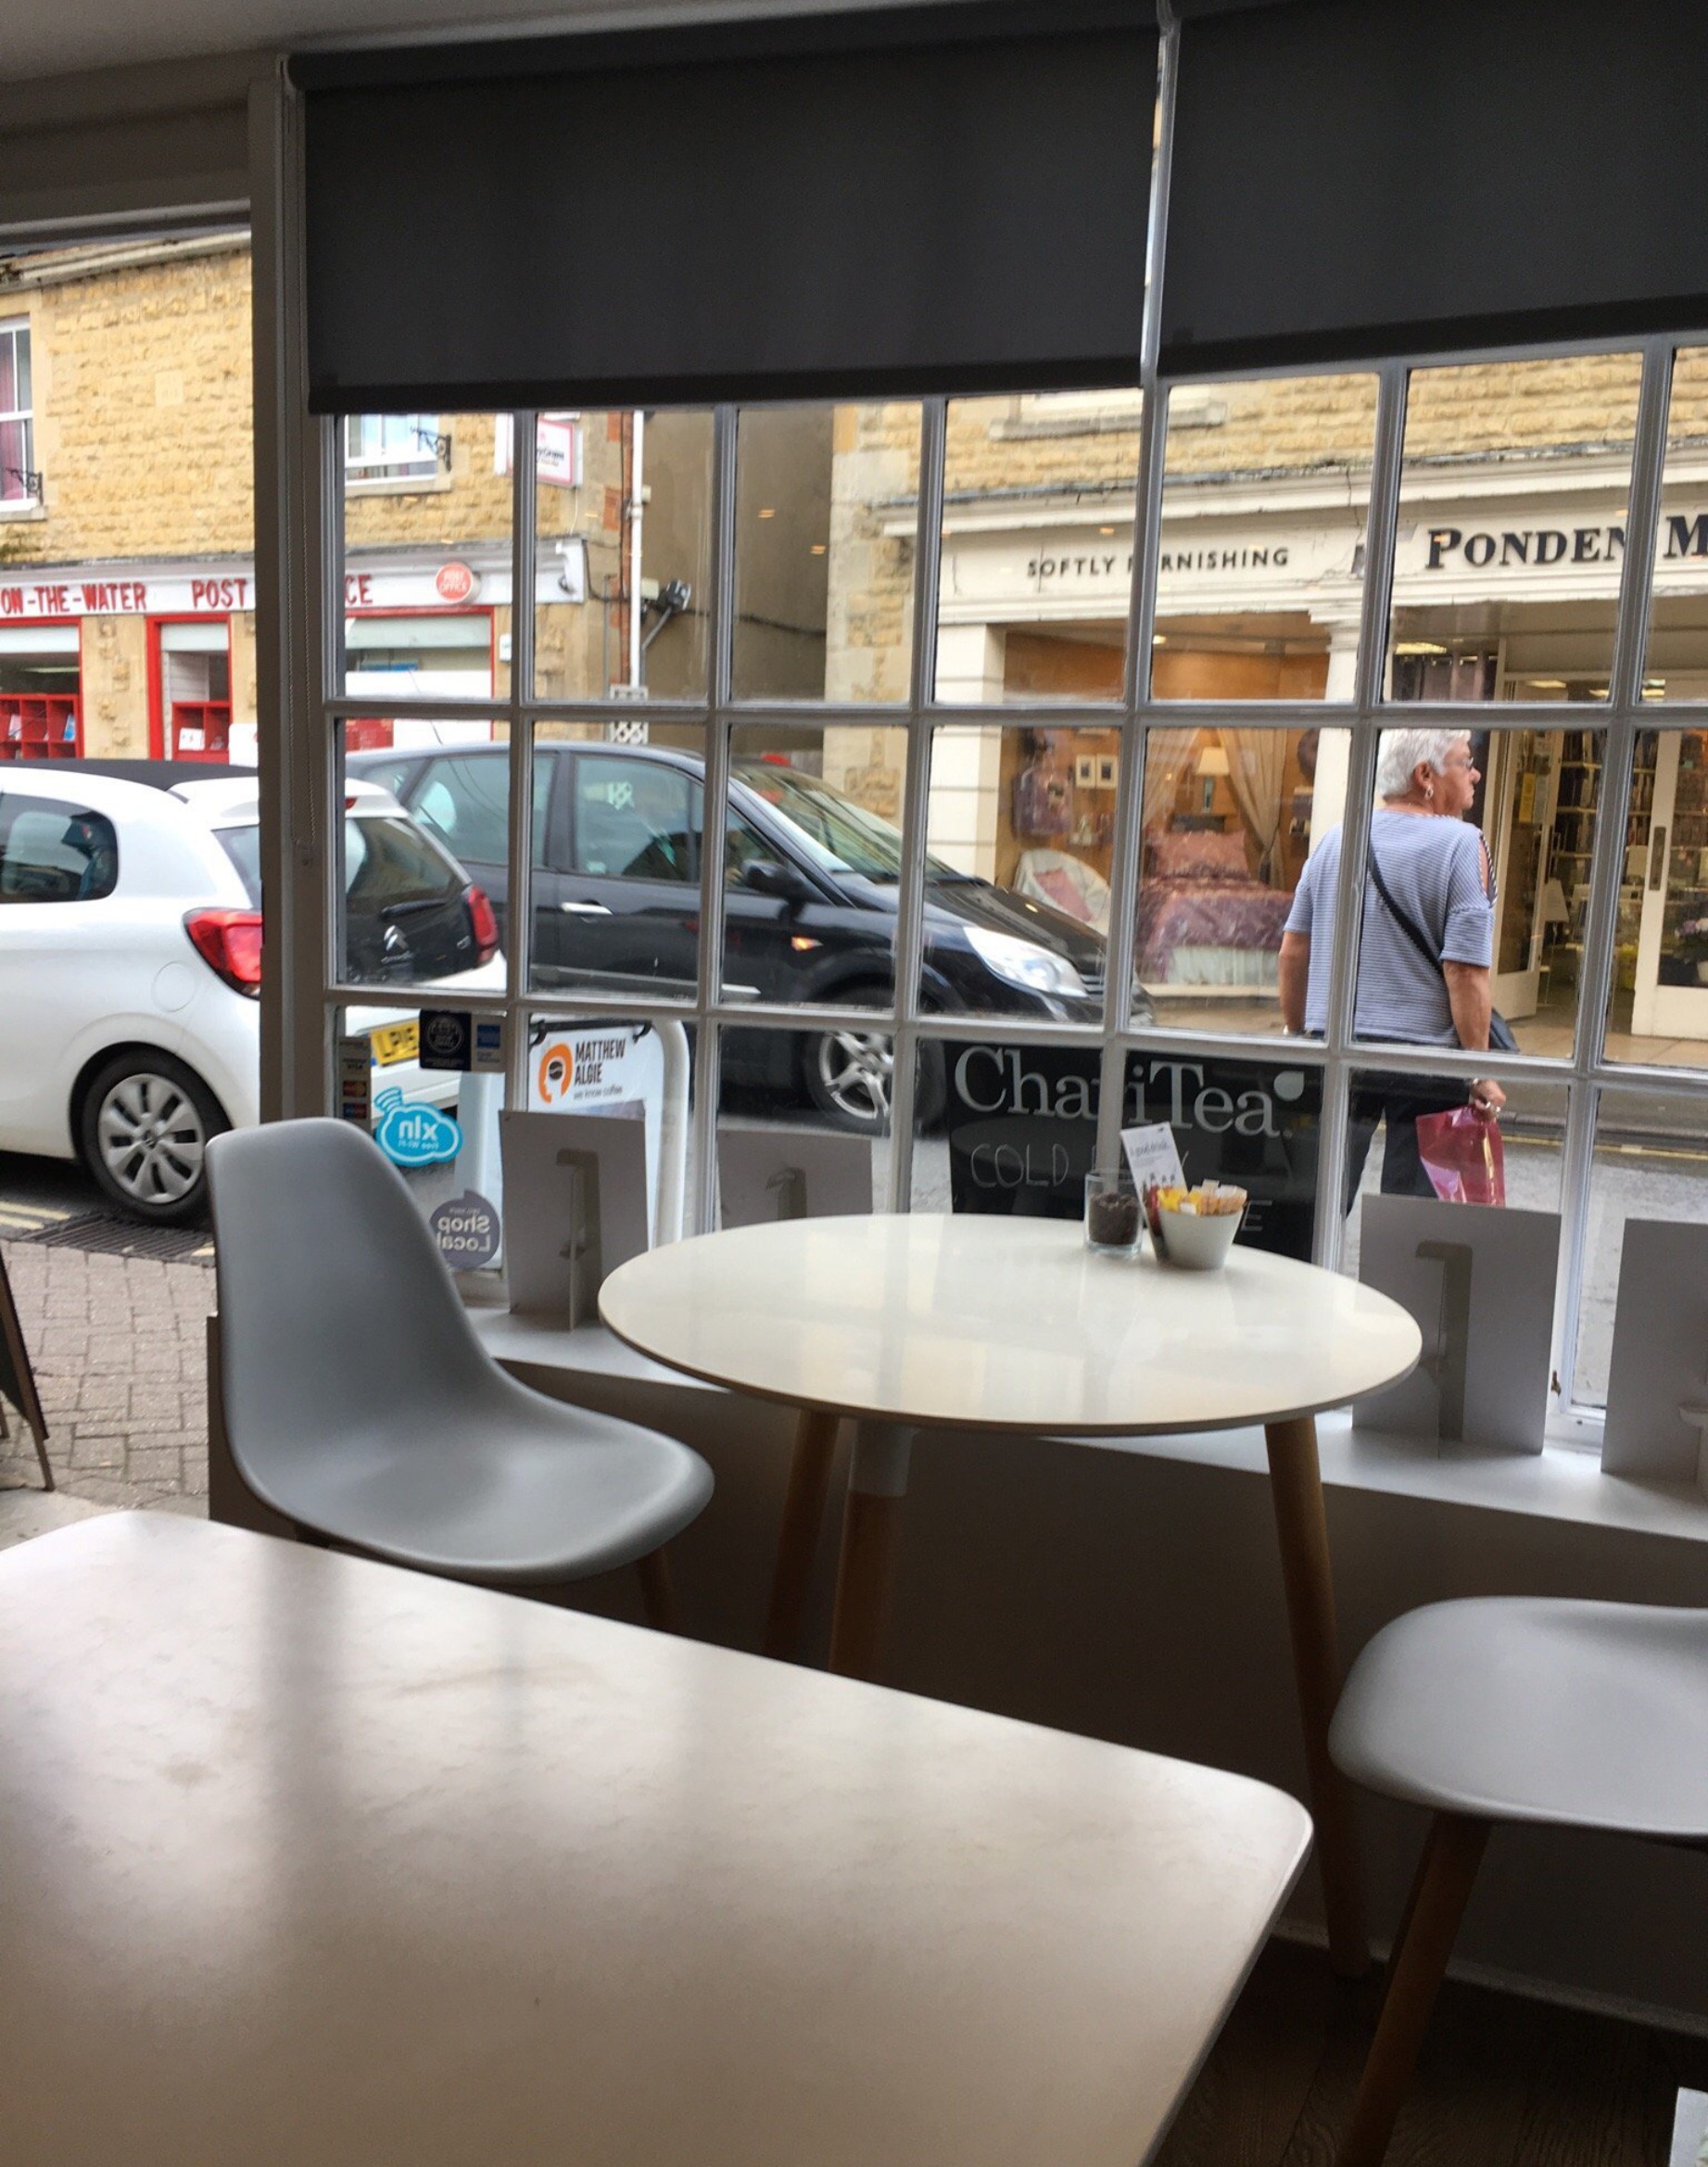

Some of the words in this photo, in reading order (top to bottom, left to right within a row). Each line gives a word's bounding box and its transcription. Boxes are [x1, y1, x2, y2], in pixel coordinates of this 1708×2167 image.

[1027, 555, 1117, 577] SOFTLY
[1127, 547, 1289, 574] RNISHING
[191, 578, 247, 608] POST
[575, 1038, 626, 1063] MATTHEW
[574, 1062, 603, 1086] ALGIE
[955, 1045, 1281, 1138] ChaiTea
[970, 1143, 1069, 1189] COLD
